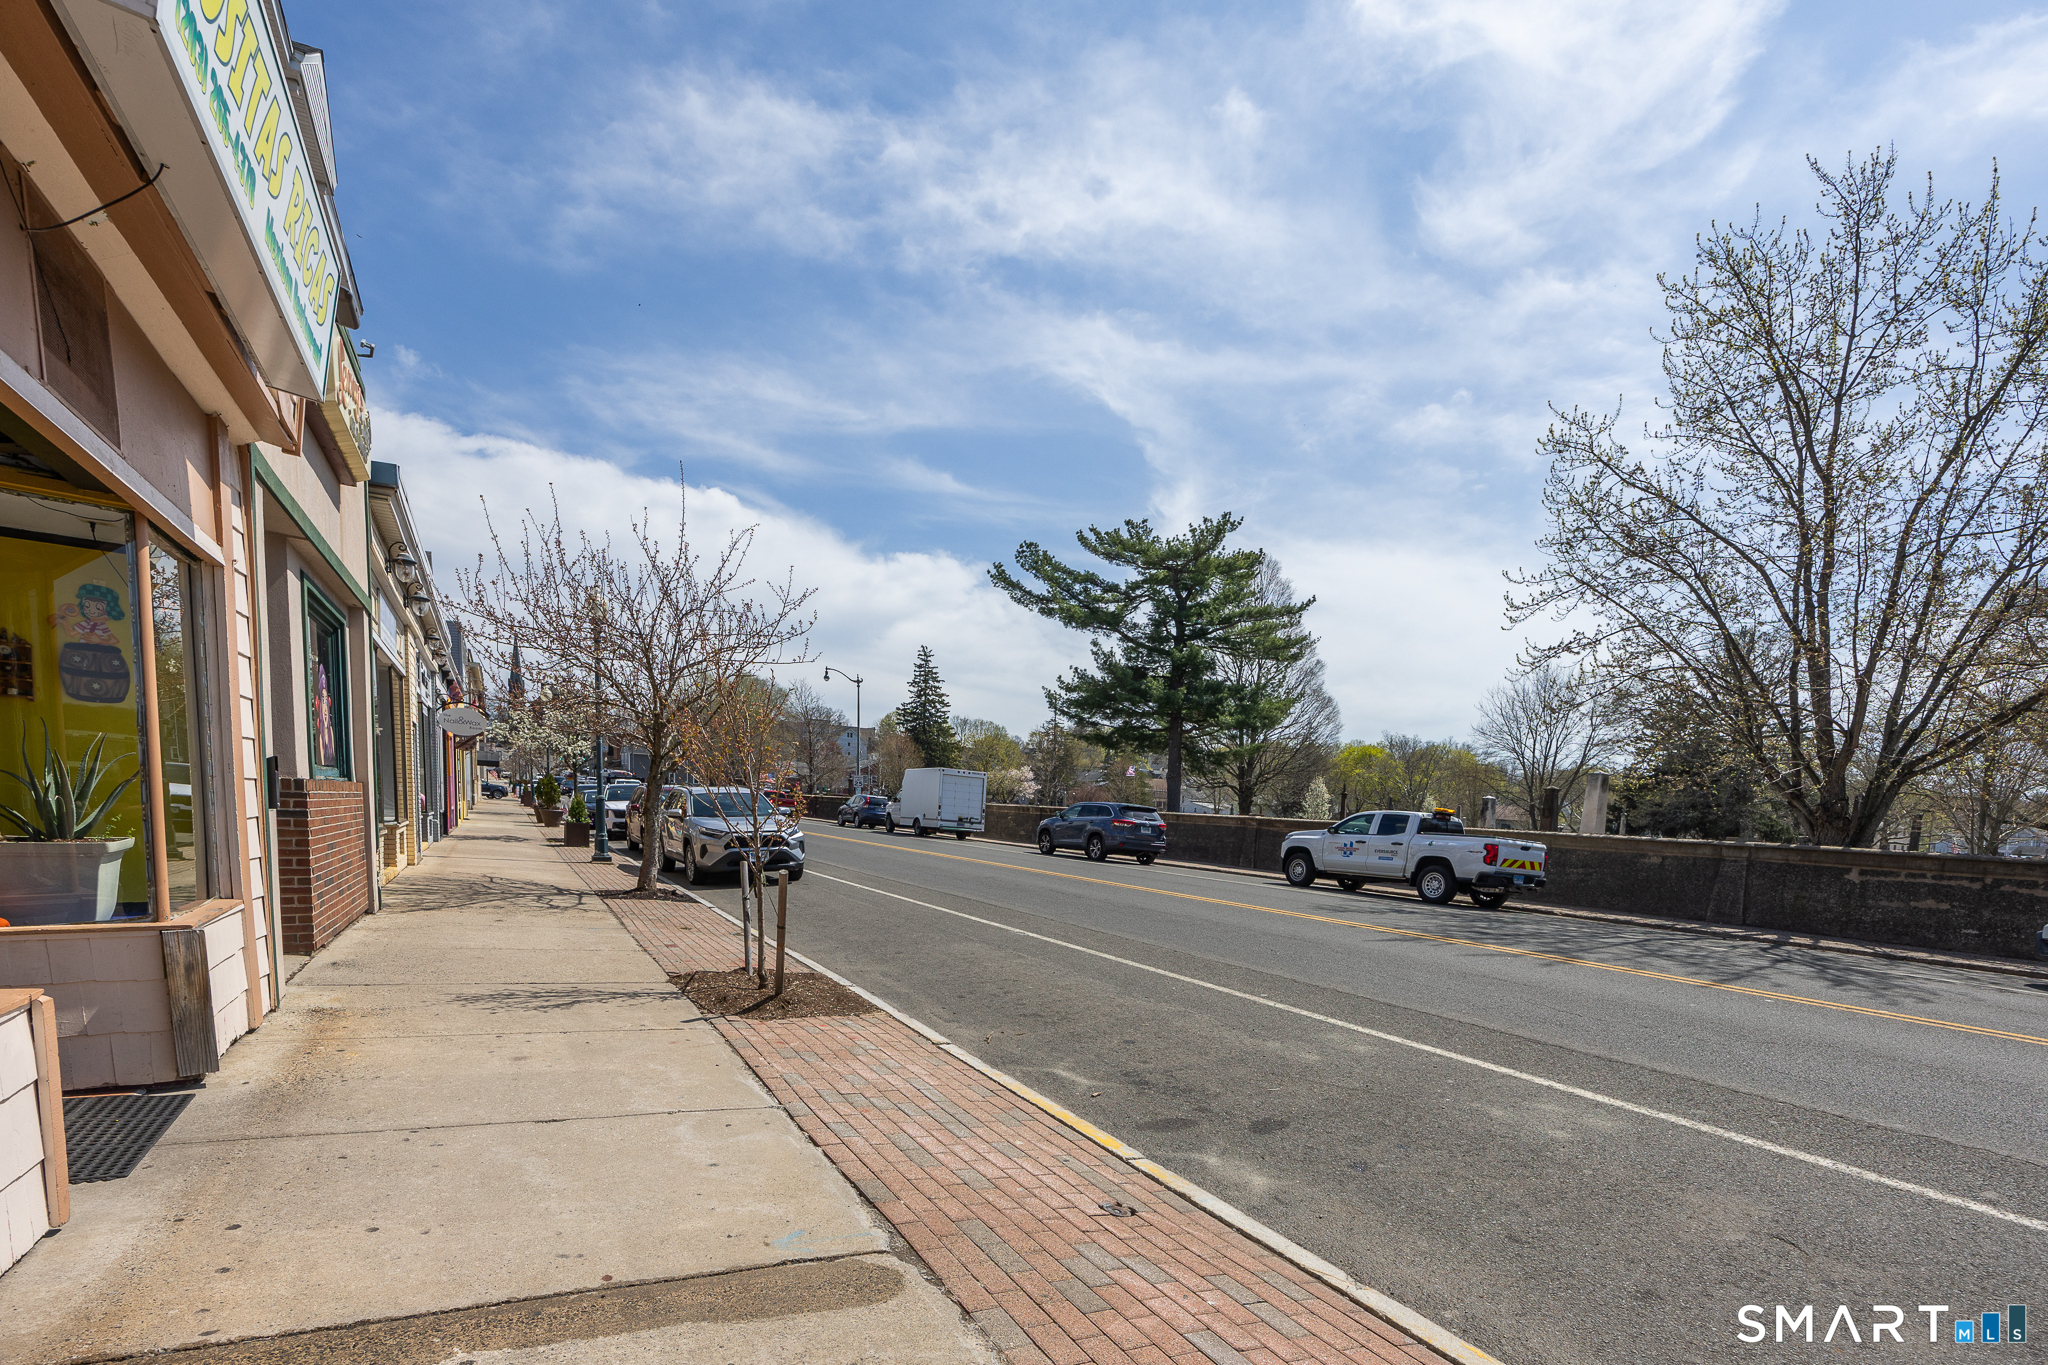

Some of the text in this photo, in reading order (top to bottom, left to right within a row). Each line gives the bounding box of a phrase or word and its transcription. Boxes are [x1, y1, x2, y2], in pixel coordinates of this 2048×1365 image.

[199, 0, 335, 327] SITAS RICAS
[265, 206, 323, 371] Mexican Restaurant
